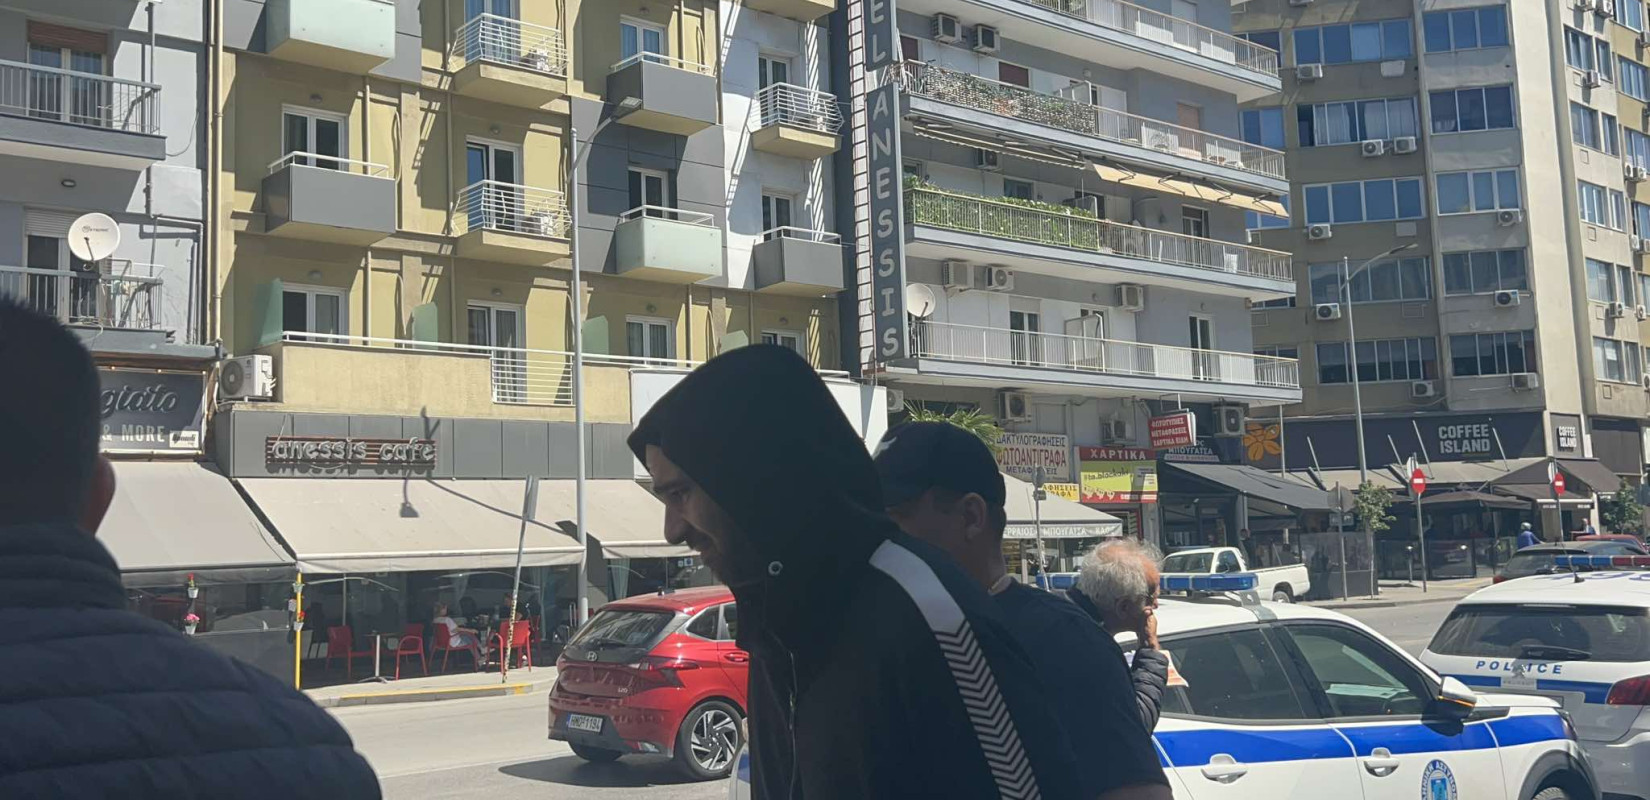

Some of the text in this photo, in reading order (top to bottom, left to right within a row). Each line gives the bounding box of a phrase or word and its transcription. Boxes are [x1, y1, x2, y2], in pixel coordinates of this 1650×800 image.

[871, 91, 899, 357] ANESSIS
[102, 424, 113, 441] &
[121, 424, 166, 443] MORE
[1438, 424, 1490, 440] COFFEE
[1558, 426, 1576, 437] COFFEE
[996, 433, 1066, 447] ΔΑΚΤΥΛΟΓΡΑΦΗΣΕΙΣ
[1440, 438, 1491, 454] ISLAND
[1559, 437, 1577, 448] ISLAND
[272, 437, 434, 461] anessis cafe
[1090, 448, 1146, 460] ΧΑΡΤΙΚΑ
[996, 447, 1067, 467] ΦΩΤΟΑΝΤΙΓΡΑΦΑ
[1006, 466, 1057, 475] ΜΕΤΑΦΕΙΣ
[1476, 660, 1563, 674] POLICE
